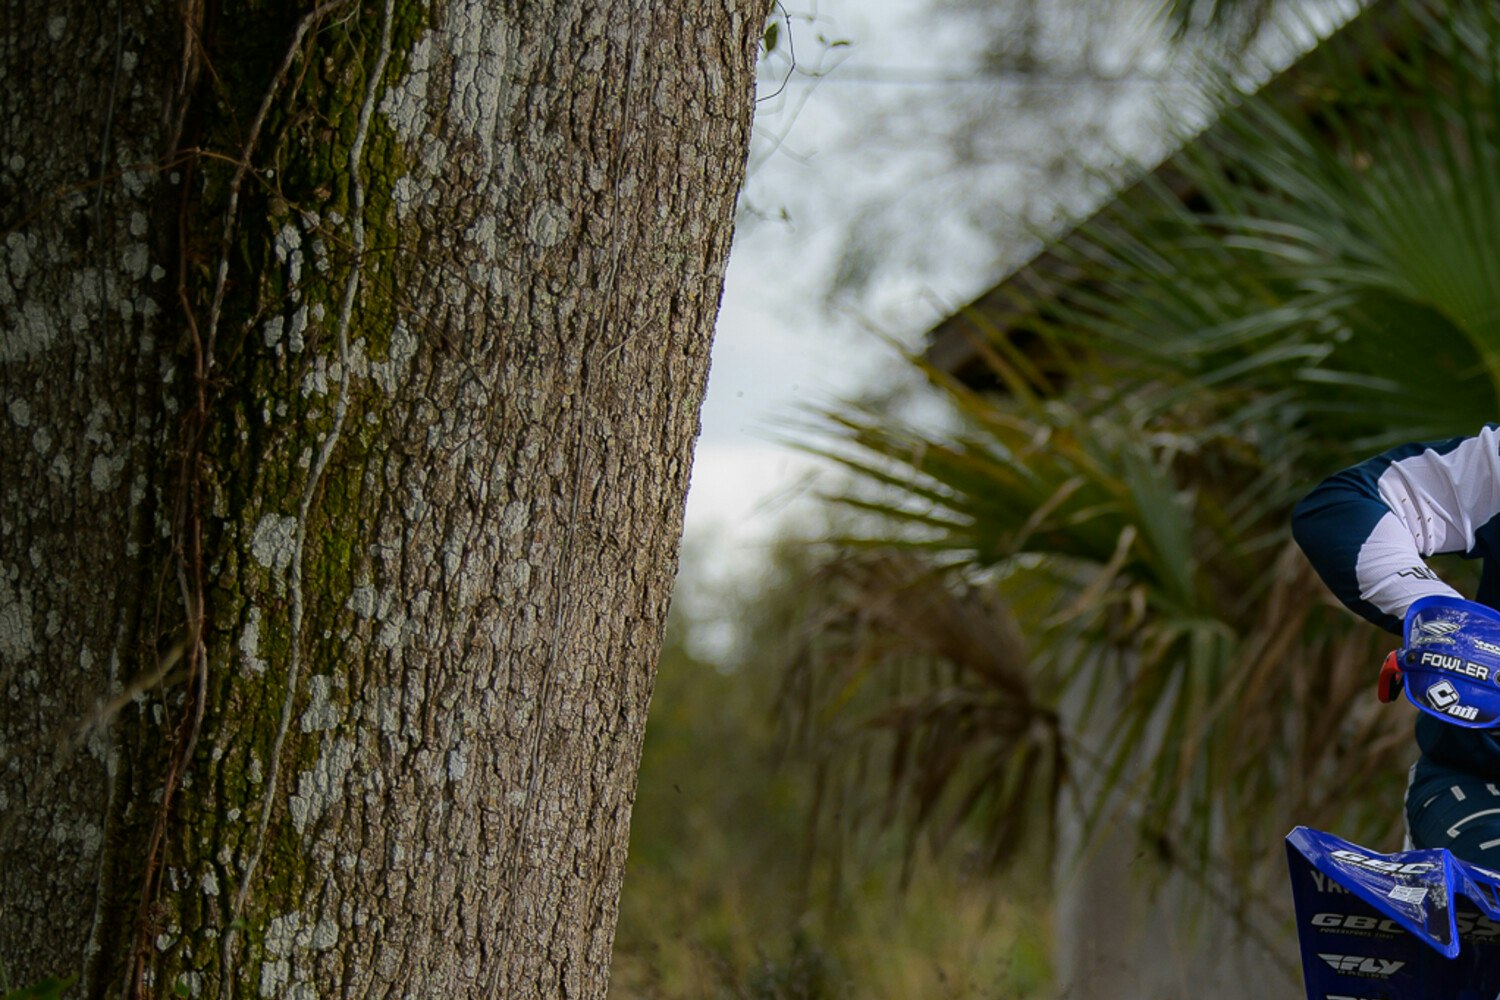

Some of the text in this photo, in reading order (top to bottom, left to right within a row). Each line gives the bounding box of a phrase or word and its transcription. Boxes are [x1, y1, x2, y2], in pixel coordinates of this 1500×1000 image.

[1420, 652, 1490, 681] FOWLER
[1330, 849, 1436, 874] GBC
[1310, 912, 1406, 934] GBC
[1318, 953, 1406, 976] FLY
